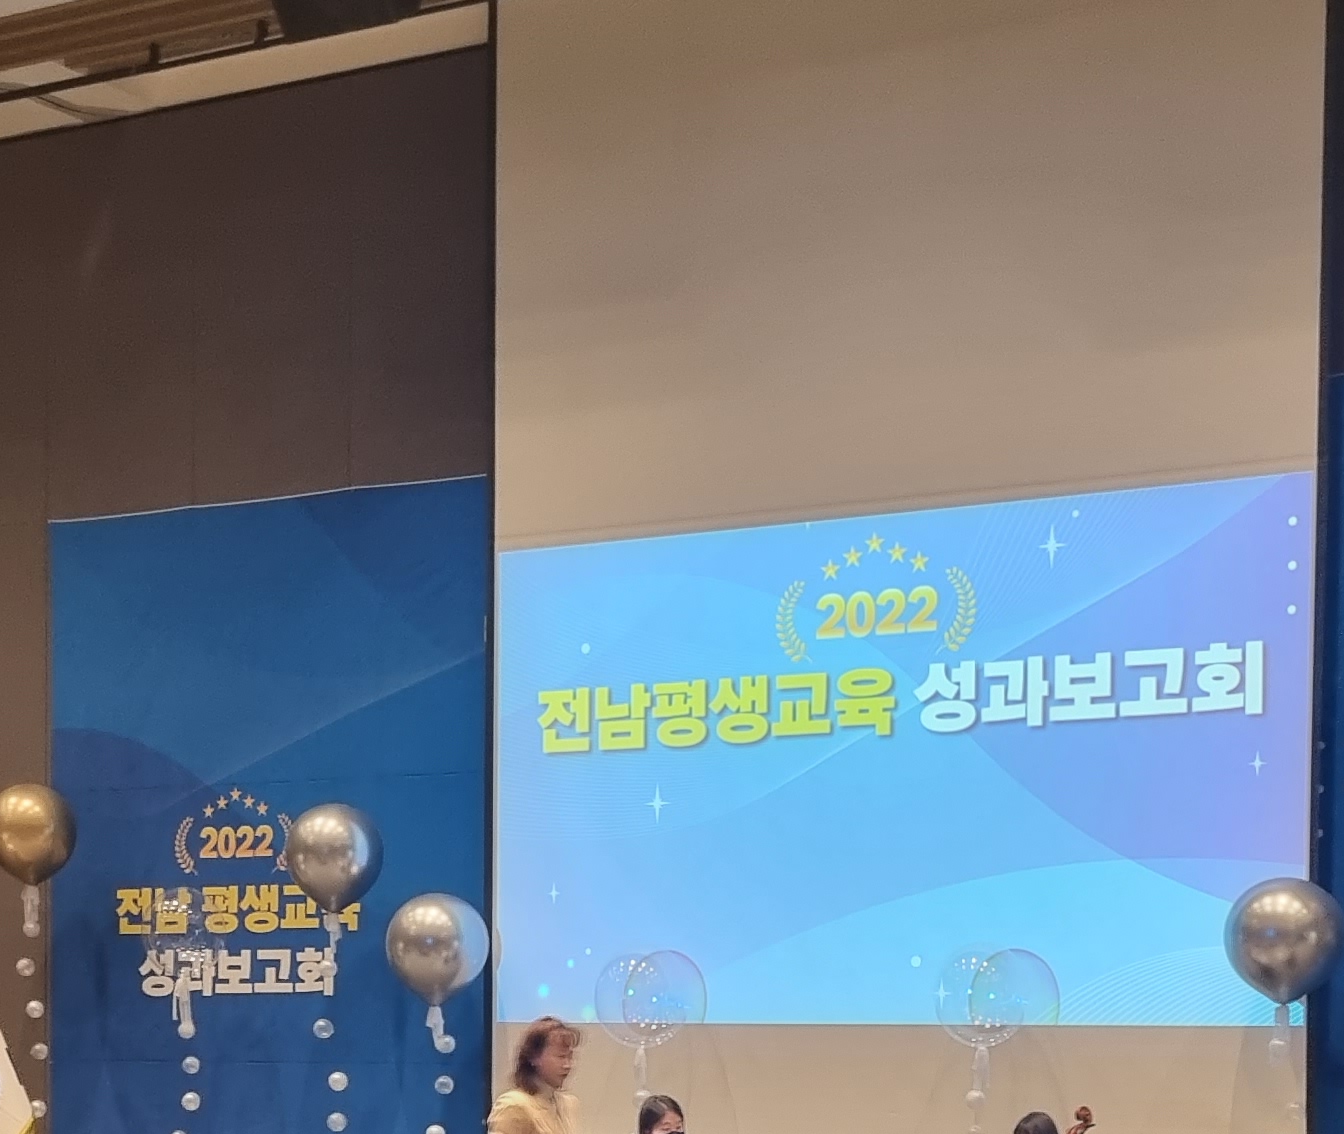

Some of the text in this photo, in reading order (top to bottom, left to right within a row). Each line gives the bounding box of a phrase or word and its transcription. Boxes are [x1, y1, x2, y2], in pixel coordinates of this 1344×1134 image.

[815, 585, 938, 641] 2022
[537, 640, 1264, 754] 전남평생교육 성과보고회
[199, 825, 274, 858] 2022
[115, 887, 193, 935] 전남
[138, 946, 335, 997] 성과보고회
